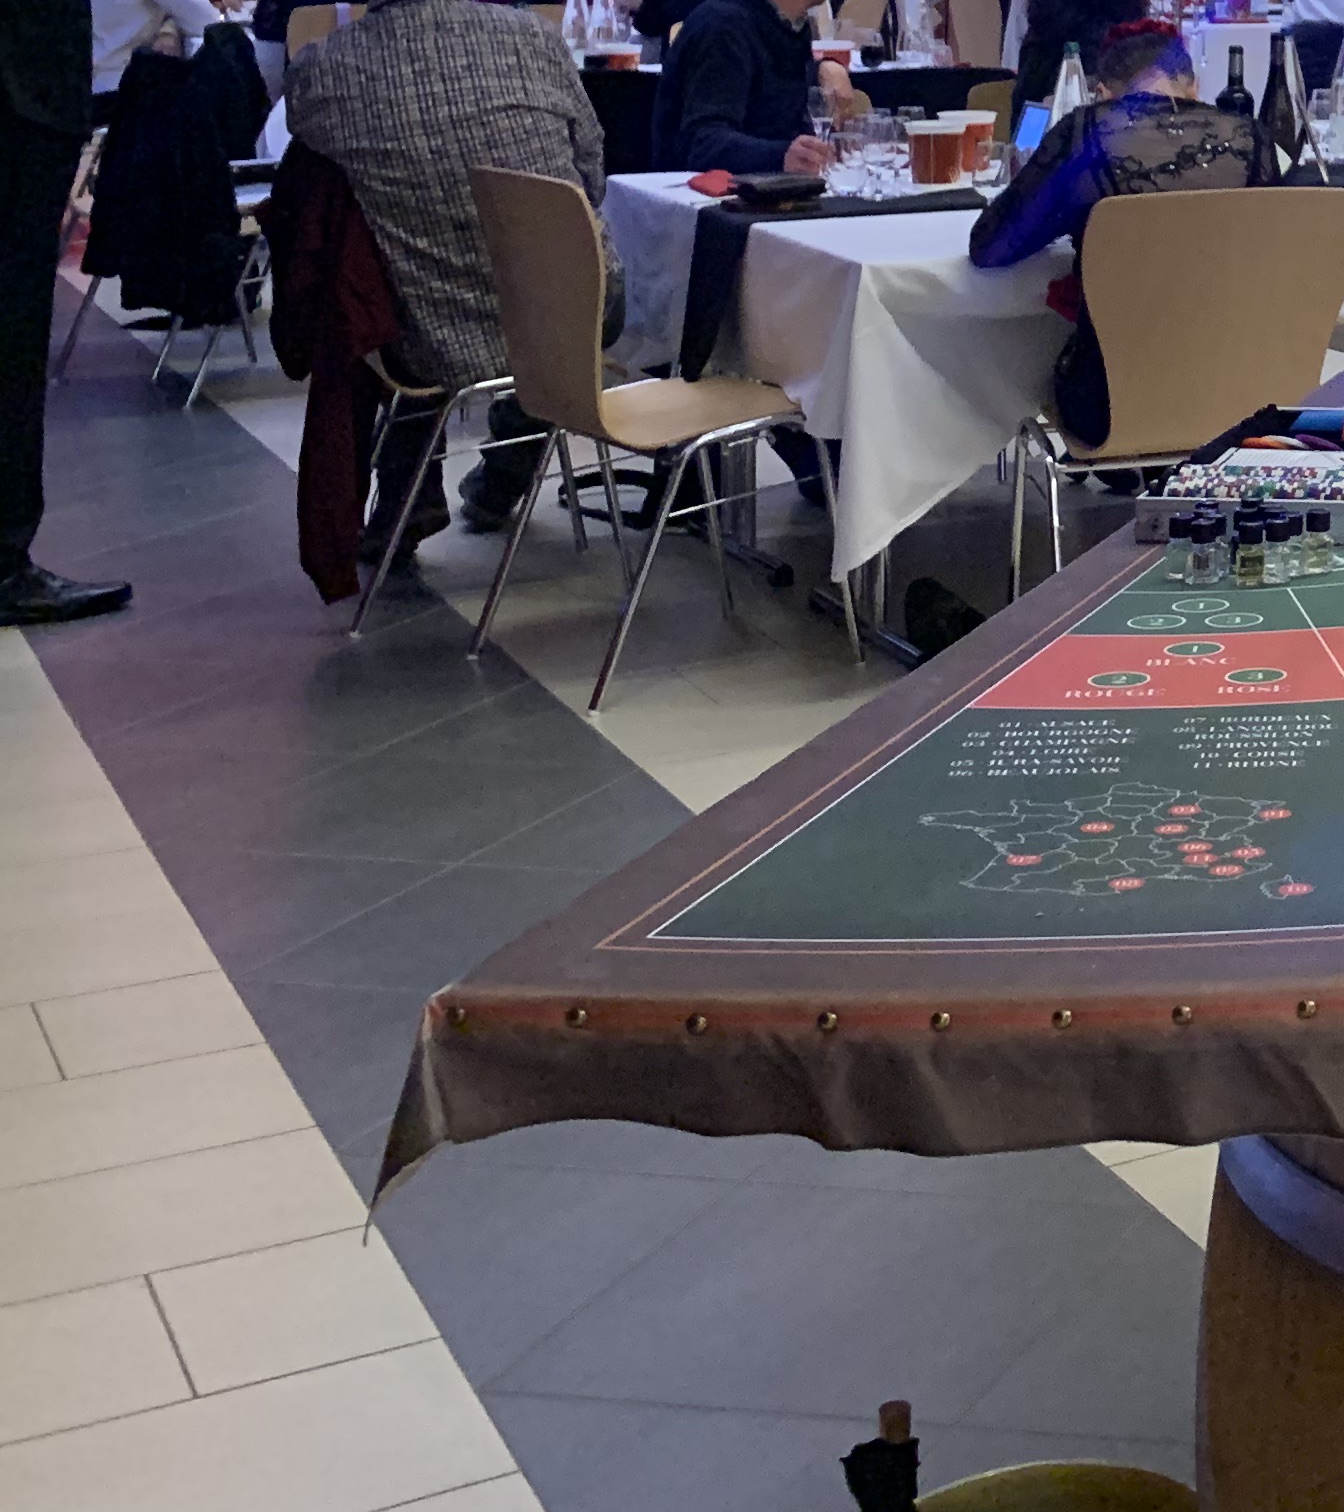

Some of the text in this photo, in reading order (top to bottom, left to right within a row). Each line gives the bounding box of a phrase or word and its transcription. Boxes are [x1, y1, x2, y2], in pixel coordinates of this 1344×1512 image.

[1192, 645, 1199, 653] 1
[1146, 657, 1236, 666] BLANC
[1111, 675, 1127, 684] 2
[1247, 672, 1264, 680] 3
[1064, 688, 1166, 698] ROUGE
[1217, 684, 1292, 694] ROSE
[1220, 714, 1331, 723] BORDEAUX
[1005, 728, 1138, 737] BOURGOGNE
[999, 738, 1136, 747] CHAMPAGNE
[1216, 740, 1330, 749] PROVENCE
[1233, 750, 1304, 758] CORSE
[987, 767, 1120, 776] BEAUJOLAIS
